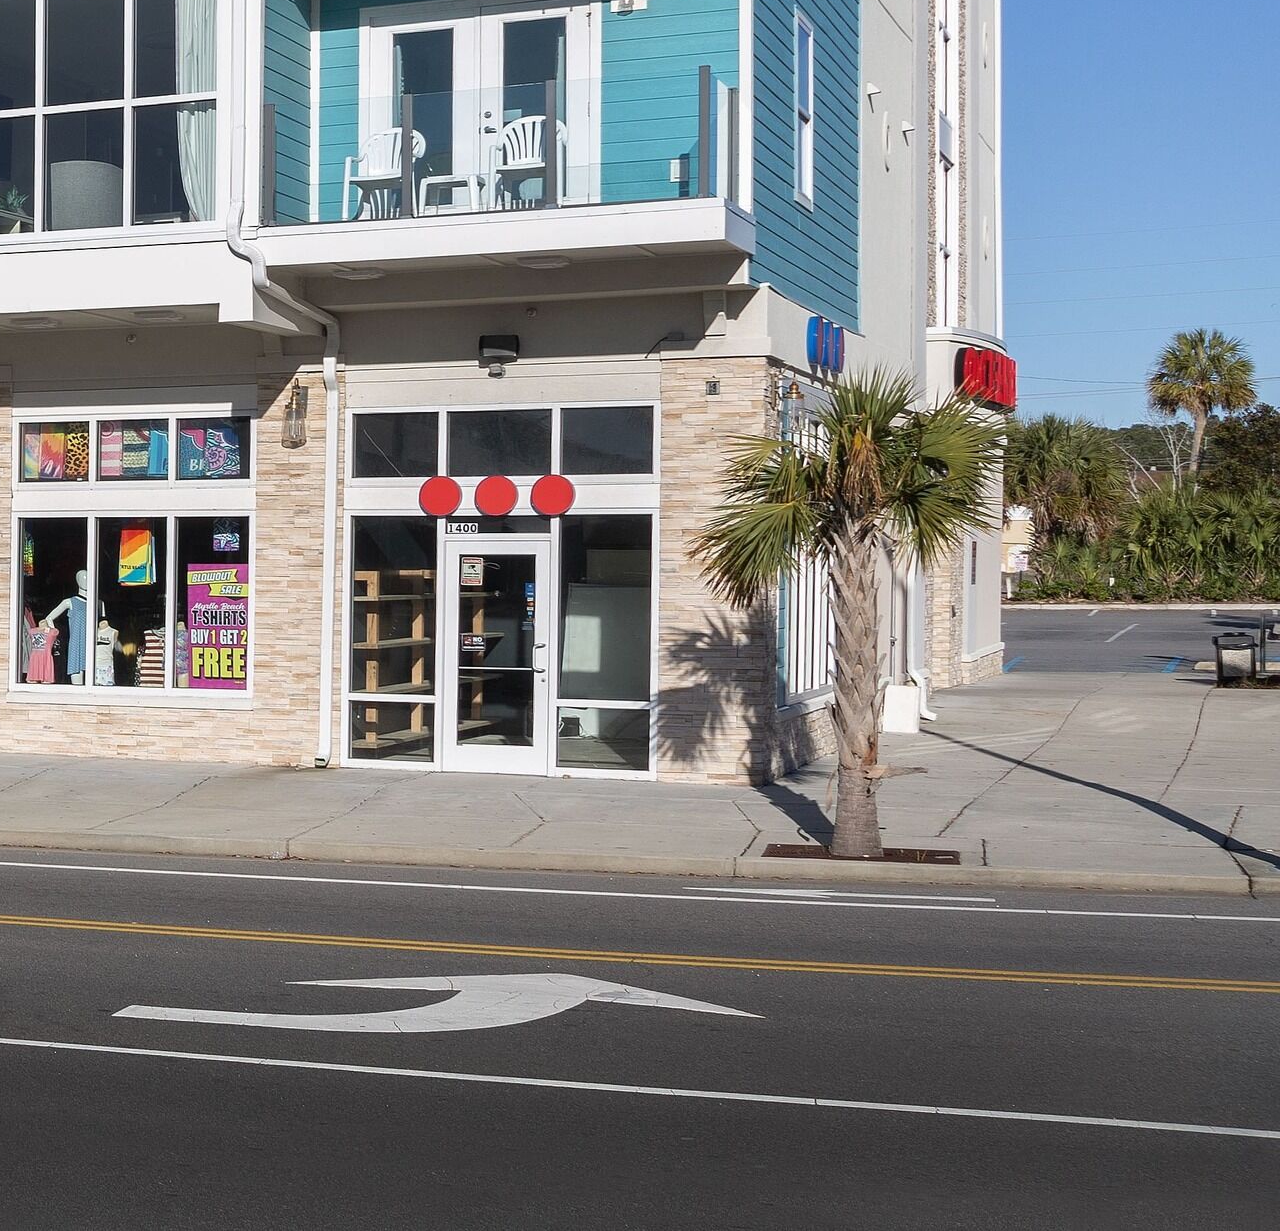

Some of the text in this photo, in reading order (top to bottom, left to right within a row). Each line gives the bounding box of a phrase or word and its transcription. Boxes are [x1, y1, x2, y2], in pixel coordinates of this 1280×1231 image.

[448, 523, 478, 533] 1400
[191, 571, 232, 583] BLOWOUT
[220, 585, 242, 594] SALE
[192, 602, 245, 611] Myrtle Beach
[192, 610, 246, 626] T-SHIRTS
[190, 629, 248, 644] BUY 1 GET 2
[192, 647, 245, 679] FREE
